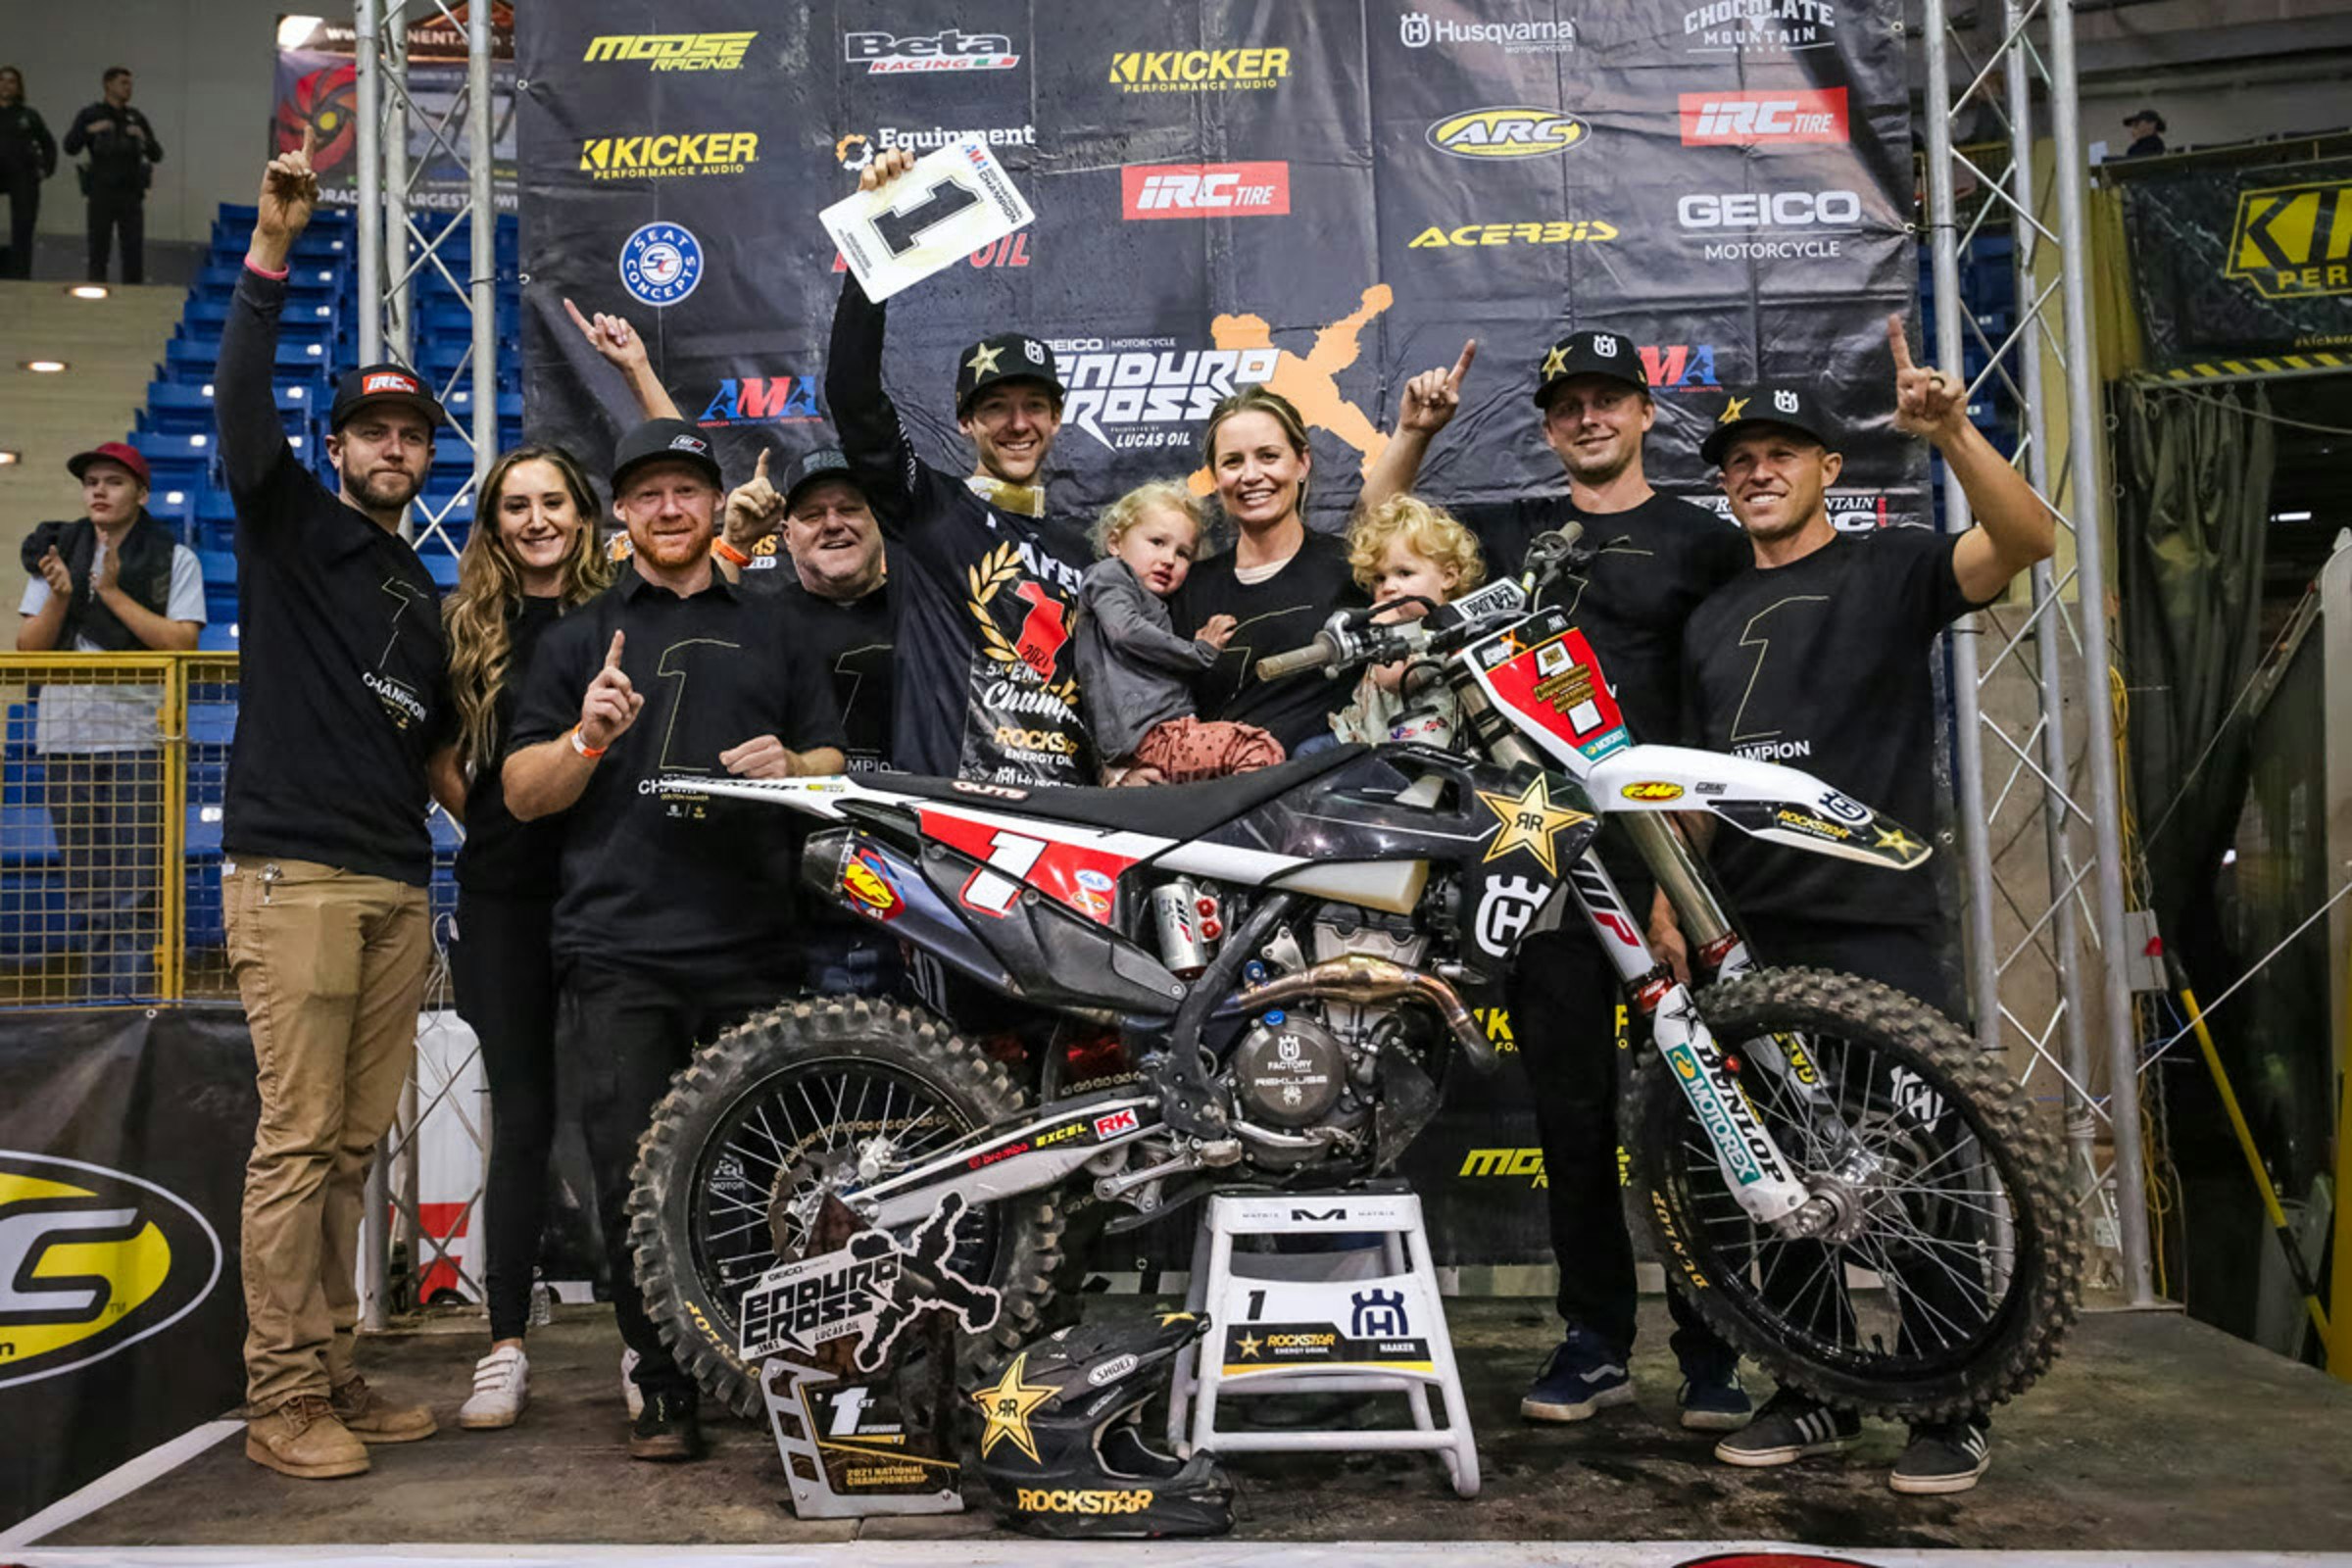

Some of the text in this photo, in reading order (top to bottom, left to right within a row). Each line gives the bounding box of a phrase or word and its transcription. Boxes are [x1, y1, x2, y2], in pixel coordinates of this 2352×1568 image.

[1435, 18, 1573, 44] Husqvarna
[1704, 26, 1816, 45] MOUNTAIN
[583, 31, 759, 62] MOOSE
[846, 29, 1010, 62] Beta
[650, 57, 742, 72] RACING
[871, 58, 967, 72] RACING
[1142, 47, 1290, 82] KICKER
[1124, 78, 1277, 93] PERFORMANCE AUDIO
[1441, 119, 1572, 146] ARC
[1793, 113, 1835, 133] TIRE
[608, 131, 758, 169] KICKER
[593, 164, 745, 180] PERFORMANCE AUDIO
[978, 170, 1018, 224] CHAMPION
[1234, 185, 1276, 206] TIRE
[868, 174, 984, 260] 1
[1679, 191, 1860, 227] GEICO
[633, 229, 690, 253] SEAT
[1705, 241, 1840, 260] MOTORCYCLE
[626, 256, 697, 299] CONCEPTS
[1111, 338, 1175, 349] MOTORCYCLE
[698, 376, 819, 419] AMA
[1114, 432, 1191, 448] LUCAS OIL
[1021, 644, 1049, 668] 2021
[1004, 748, 1055, 764] ENERGY
[1778, 810, 1850, 839] ROCKSTAR
[1267, 1059, 1312, 1070] FACTORY
[1096, 1110, 1136, 1135] RK
[1693, 1045, 1786, 1183] DUNLOP
[1035, 1123, 1088, 1148] EXCEL
[1688, 1078, 1757, 1179] MOTOREX
[1248, 1290, 1266, 1321] 1
[1267, 1334, 1336, 1348] ROCKSTAR
[1379, 1343, 1416, 1353] HAAKER
[1016, 1489, 1153, 1514] ROCKSTAR
